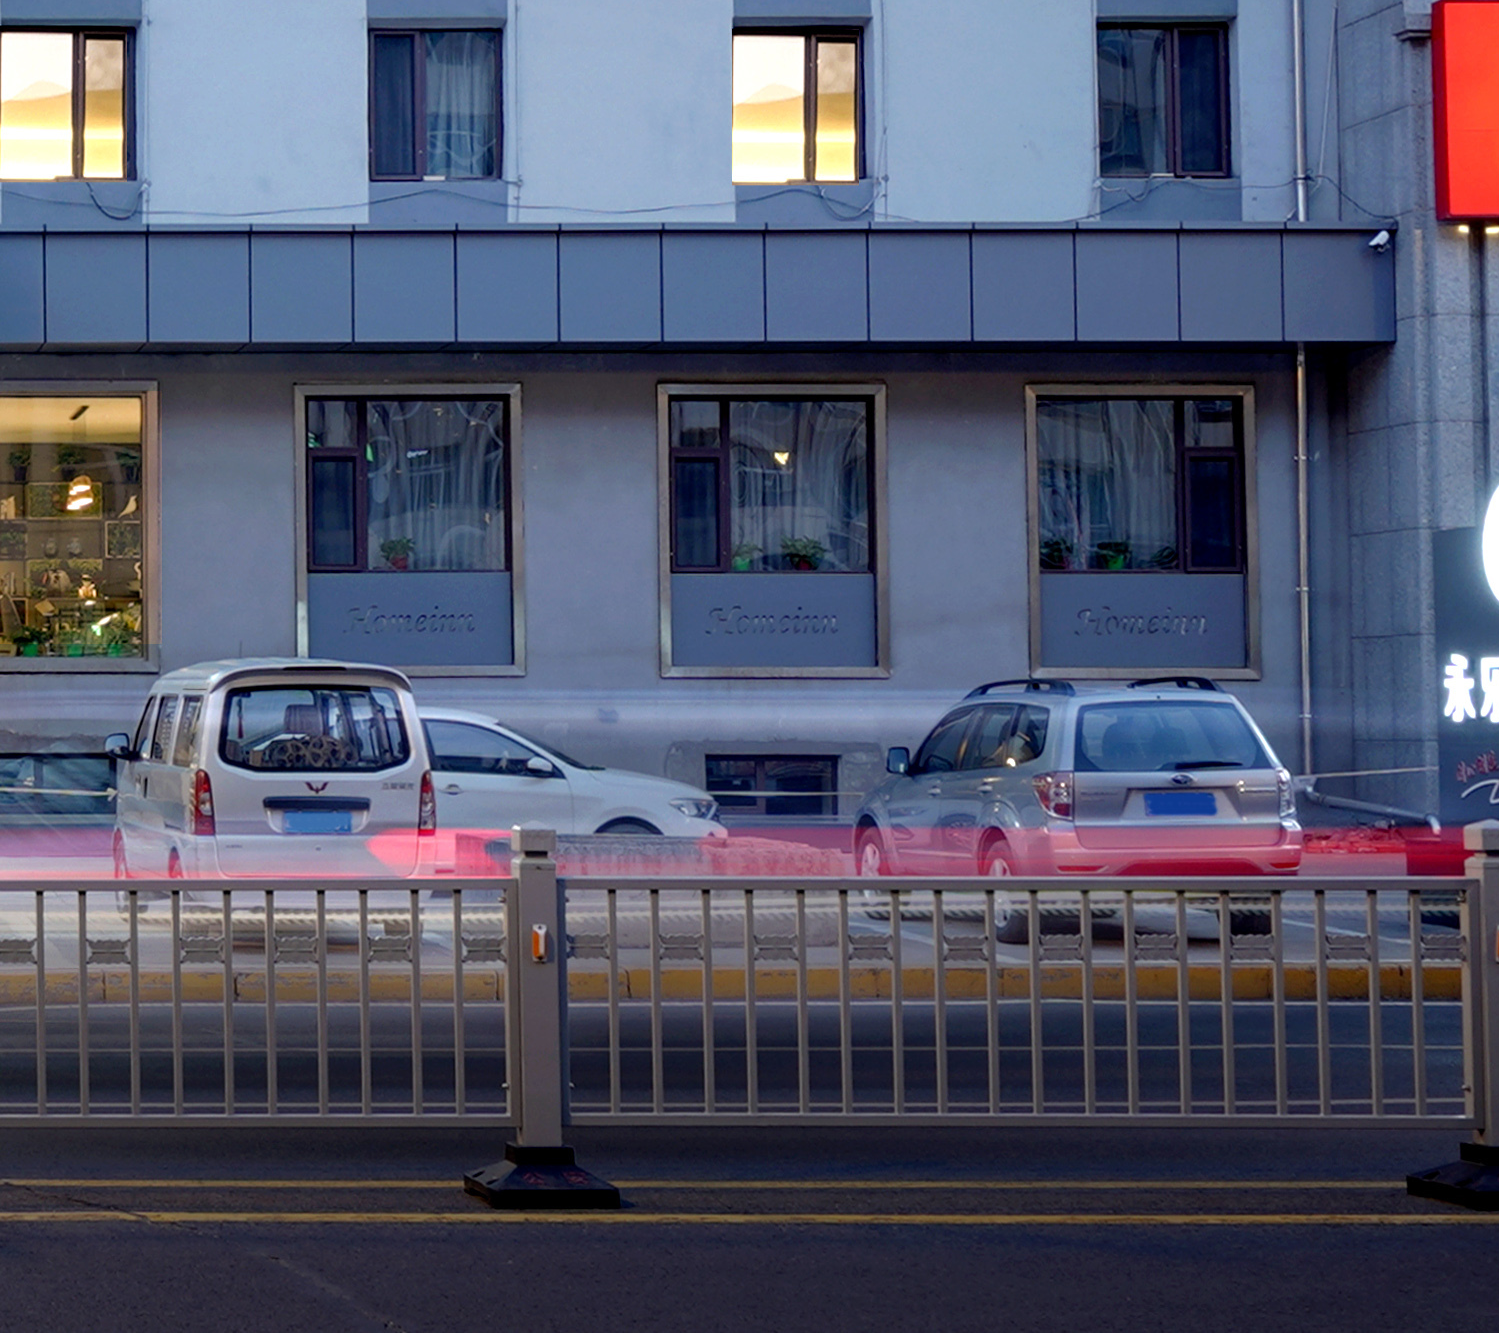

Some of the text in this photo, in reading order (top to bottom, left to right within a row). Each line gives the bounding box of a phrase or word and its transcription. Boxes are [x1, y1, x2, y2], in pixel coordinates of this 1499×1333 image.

[342, 604, 476, 634] Homeinn
[705, 605, 839, 635] Homeinn
[1074, 605, 1208, 636] Homeinn
